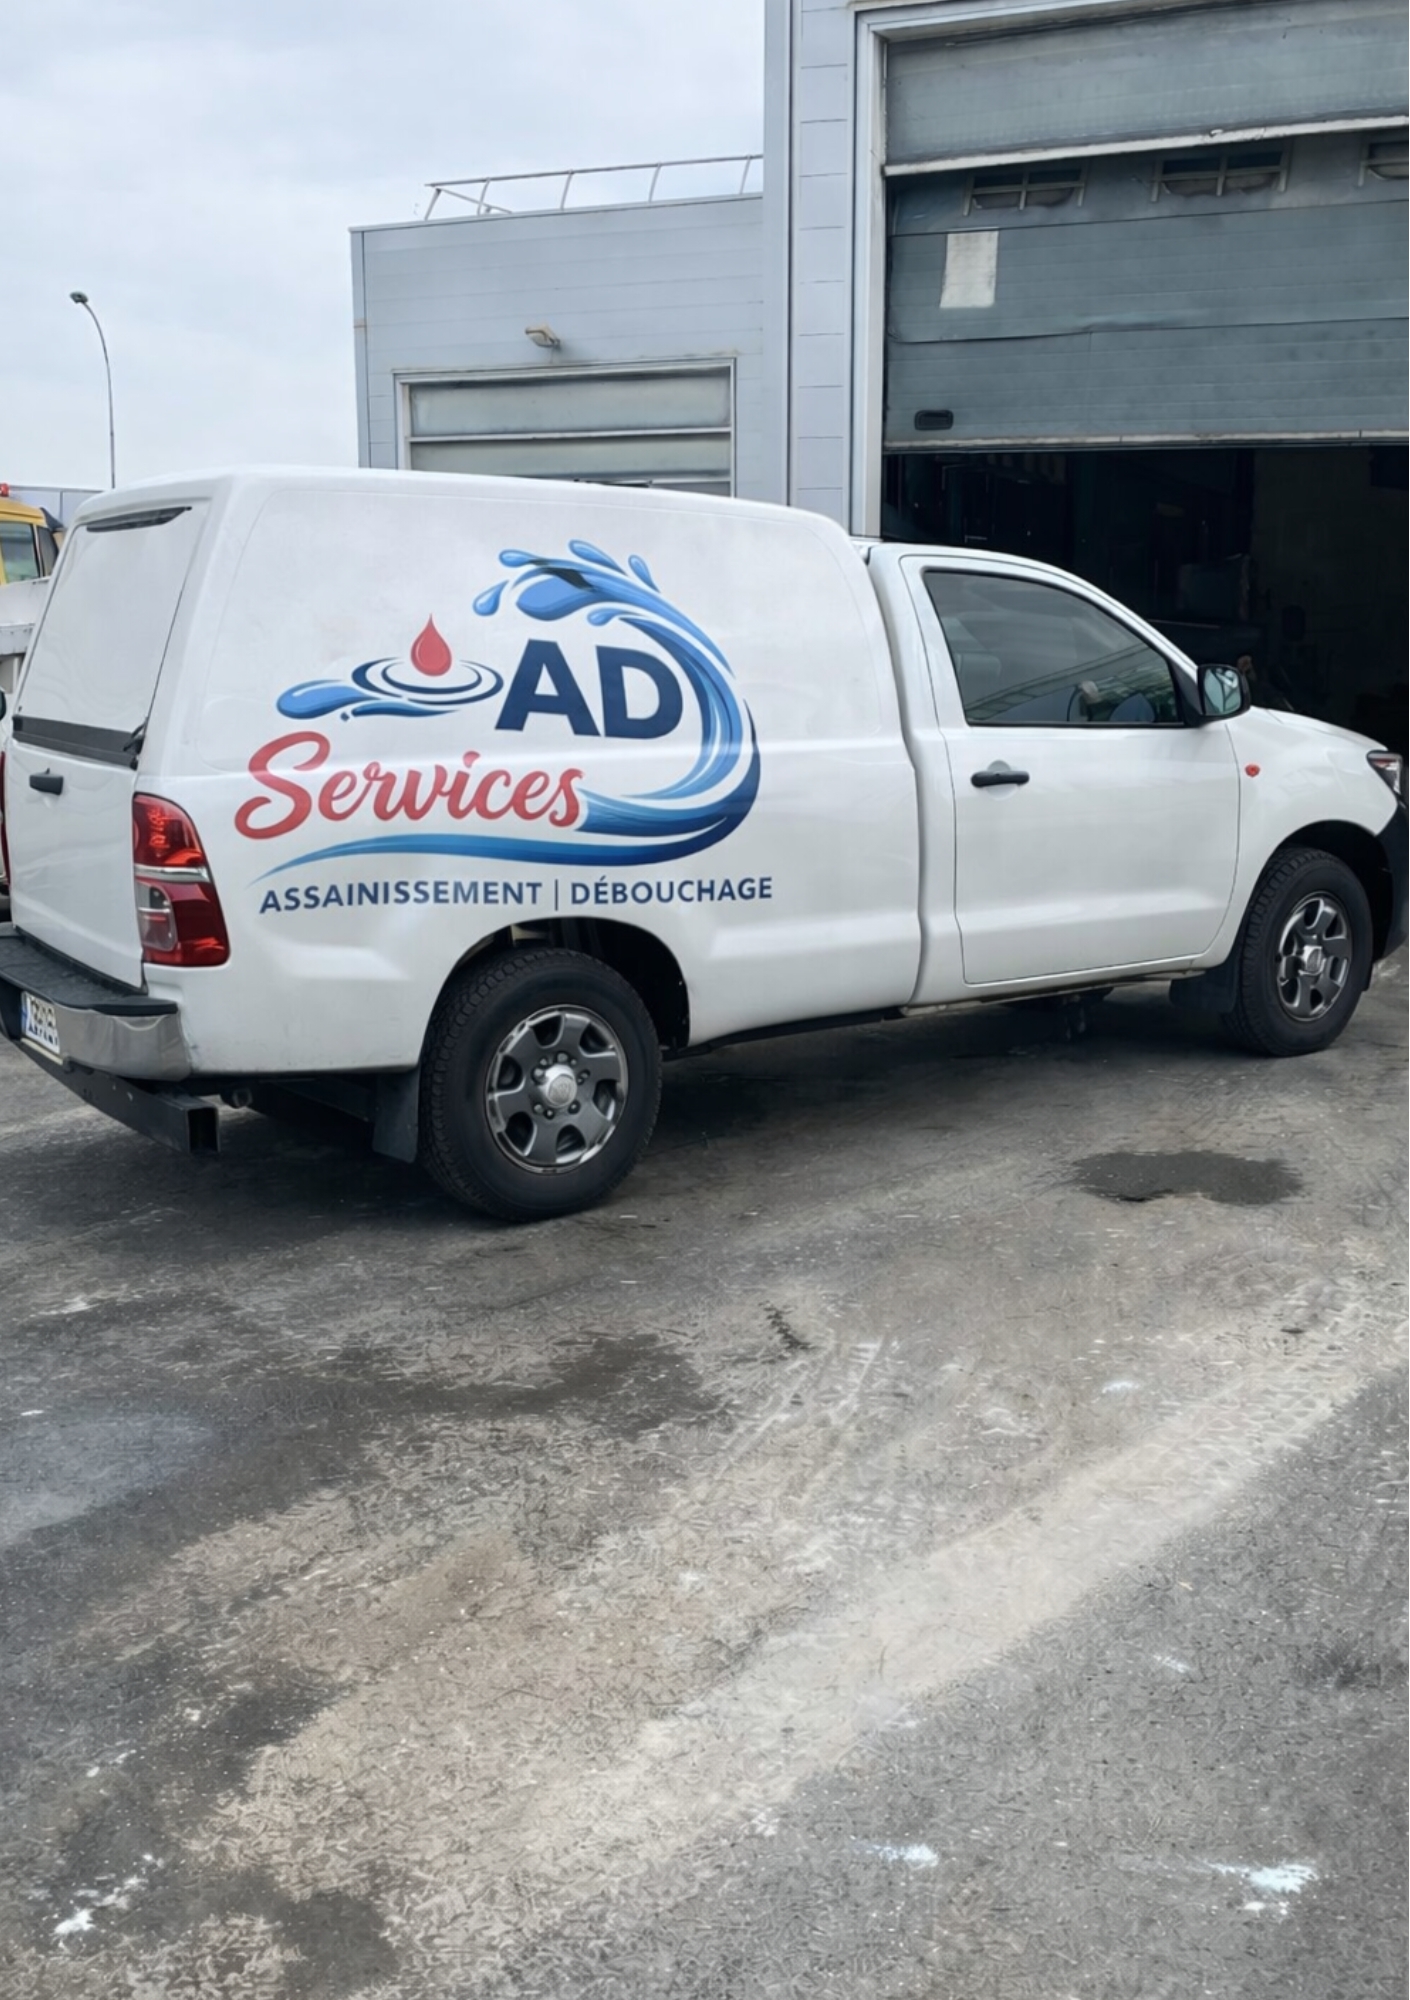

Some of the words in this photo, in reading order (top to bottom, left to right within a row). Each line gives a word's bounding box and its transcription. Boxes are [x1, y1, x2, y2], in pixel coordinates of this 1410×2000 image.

[494, 638, 683, 740] AD
[234, 731, 583, 840] Services
[259, 880, 542, 914] ASSAINISSEMENT
[571, 876, 773, 905] DÉBOUCHAGE
